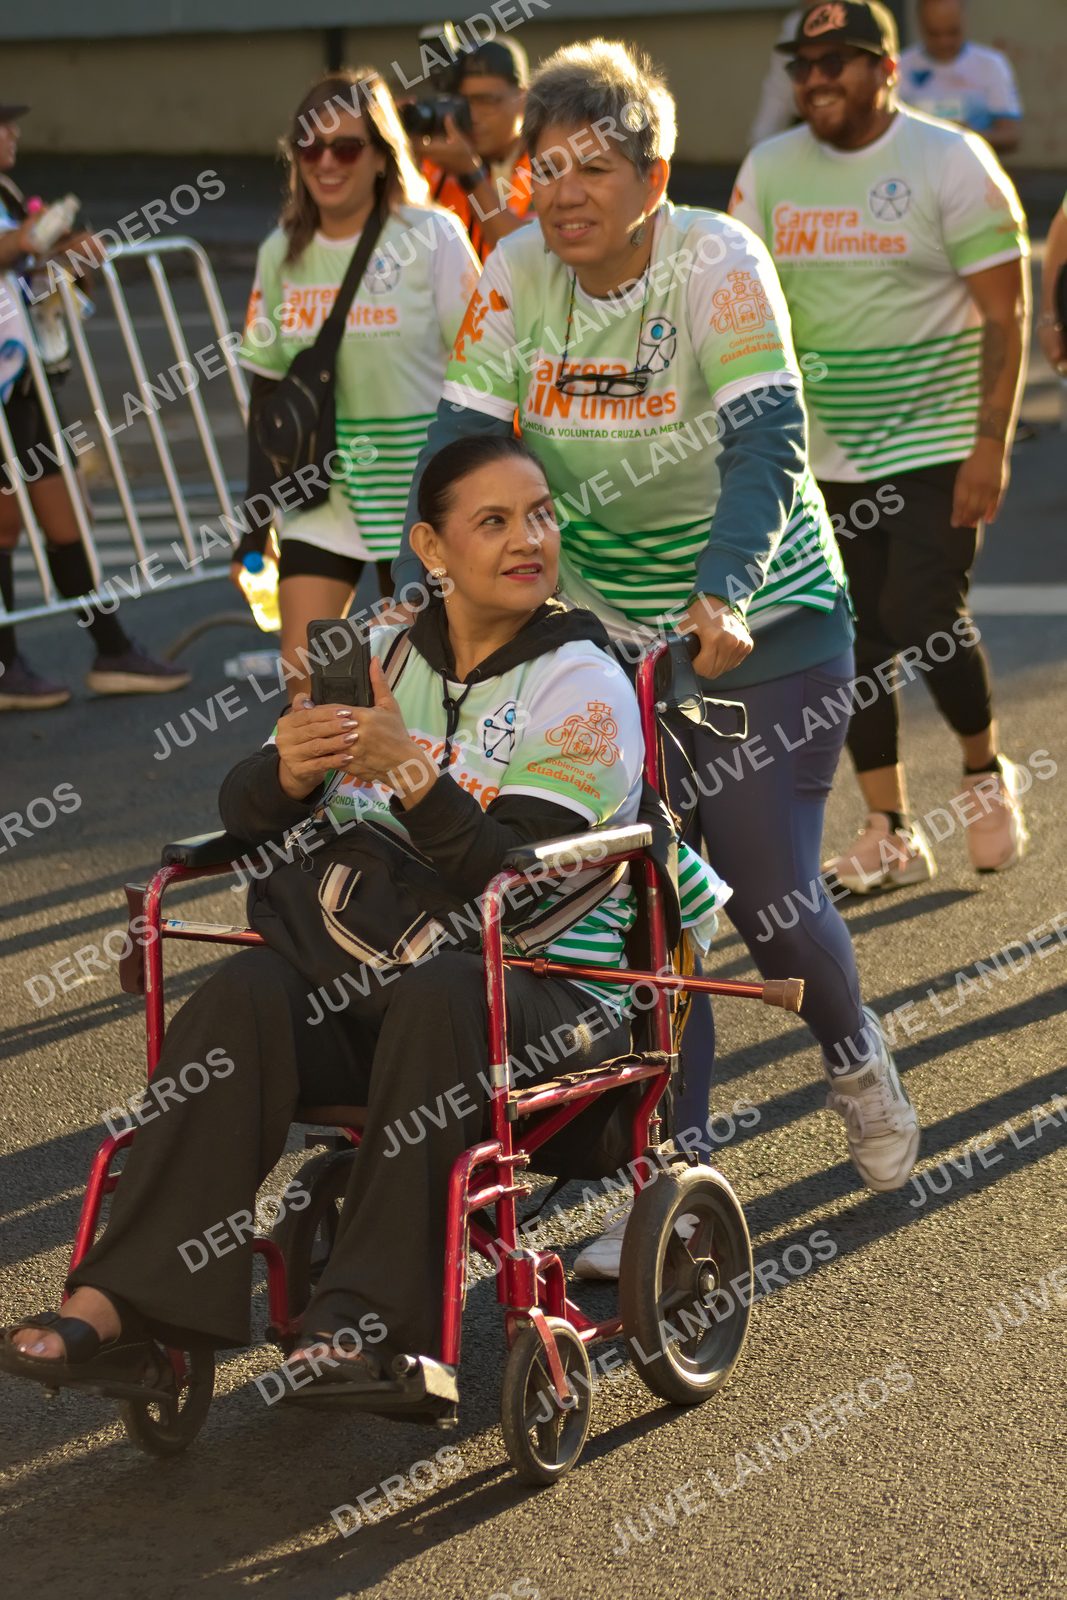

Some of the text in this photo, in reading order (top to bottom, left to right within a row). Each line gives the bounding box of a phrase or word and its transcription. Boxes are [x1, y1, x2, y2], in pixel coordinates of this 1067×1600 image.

[774, 205, 859, 229] Carrera
[775, 230, 817, 256] SIN
[321, 304, 397, 326] lites
[536, 360, 627, 384] arrera
[528, 384, 574, 419] IN
[558, 428, 609, 438] VOLUNTAD
[610, 429, 641, 439] CRUZA
[644, 427, 657, 437] LA
[660, 421, 686, 434] META
[527, 761, 601, 800] Guadalajara
[546, 757, 597, 783] Gobierno de
